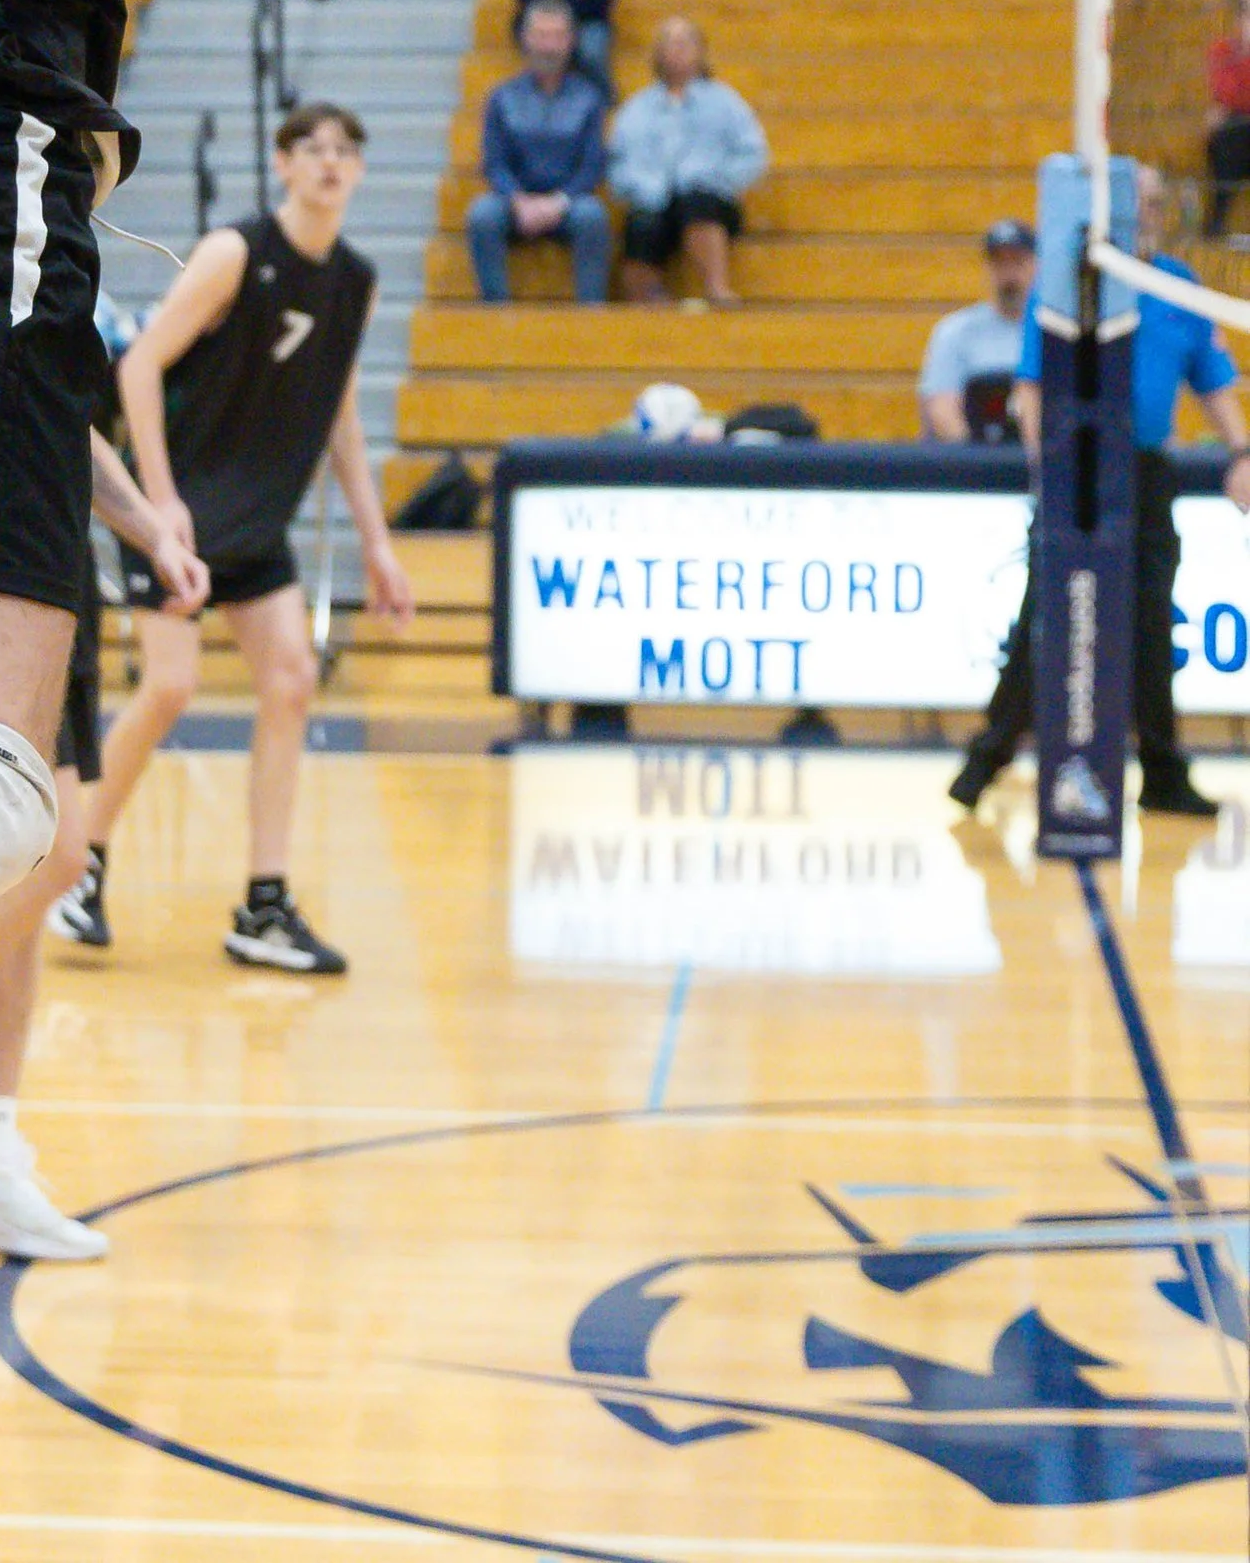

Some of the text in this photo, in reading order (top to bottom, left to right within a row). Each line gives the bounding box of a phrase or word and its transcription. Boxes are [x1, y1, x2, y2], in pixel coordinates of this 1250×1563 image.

[271, 309, 314, 363] 7
[531, 555, 923, 613] WATERFORD
[639, 636, 811, 696] MOTT
